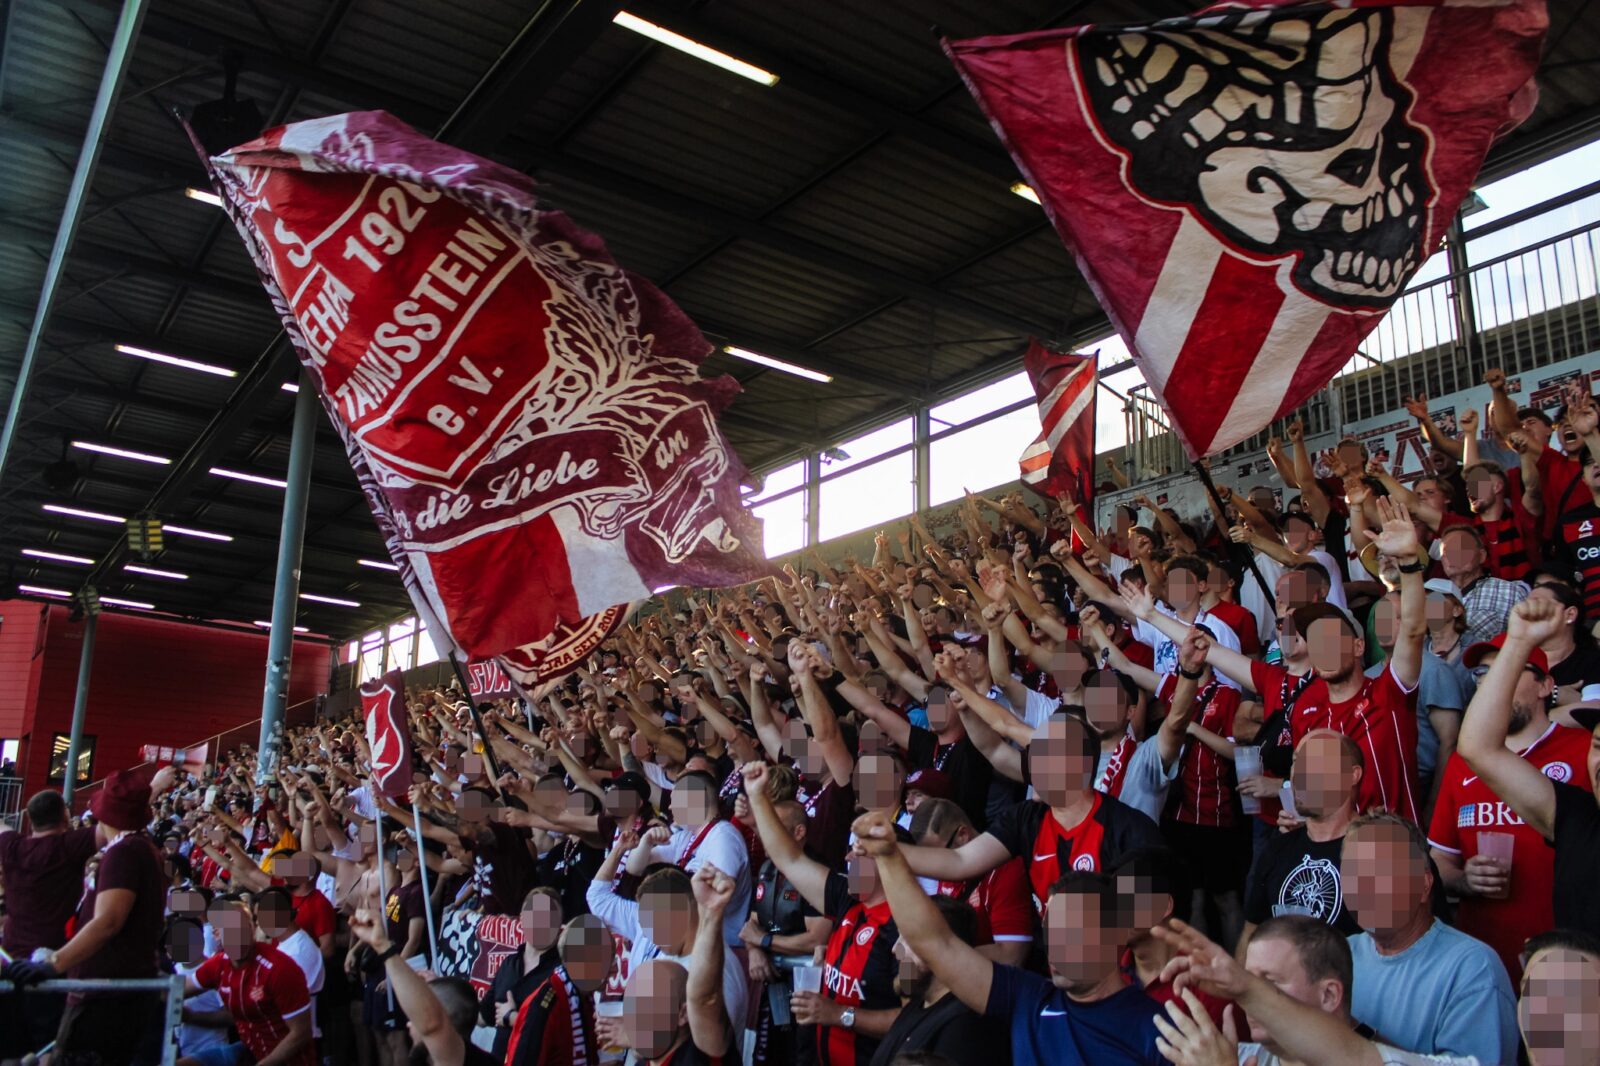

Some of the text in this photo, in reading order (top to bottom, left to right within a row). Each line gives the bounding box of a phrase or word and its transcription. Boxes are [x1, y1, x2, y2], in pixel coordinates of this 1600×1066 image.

[415, 491, 474, 531] die
[480, 451, 600, 510] Liebe
[1577, 546, 1600, 561] Ce
[573, 631, 601, 657] SEIT
[1477, 801, 1525, 827] BR
[824, 963, 866, 1001] BRITA
